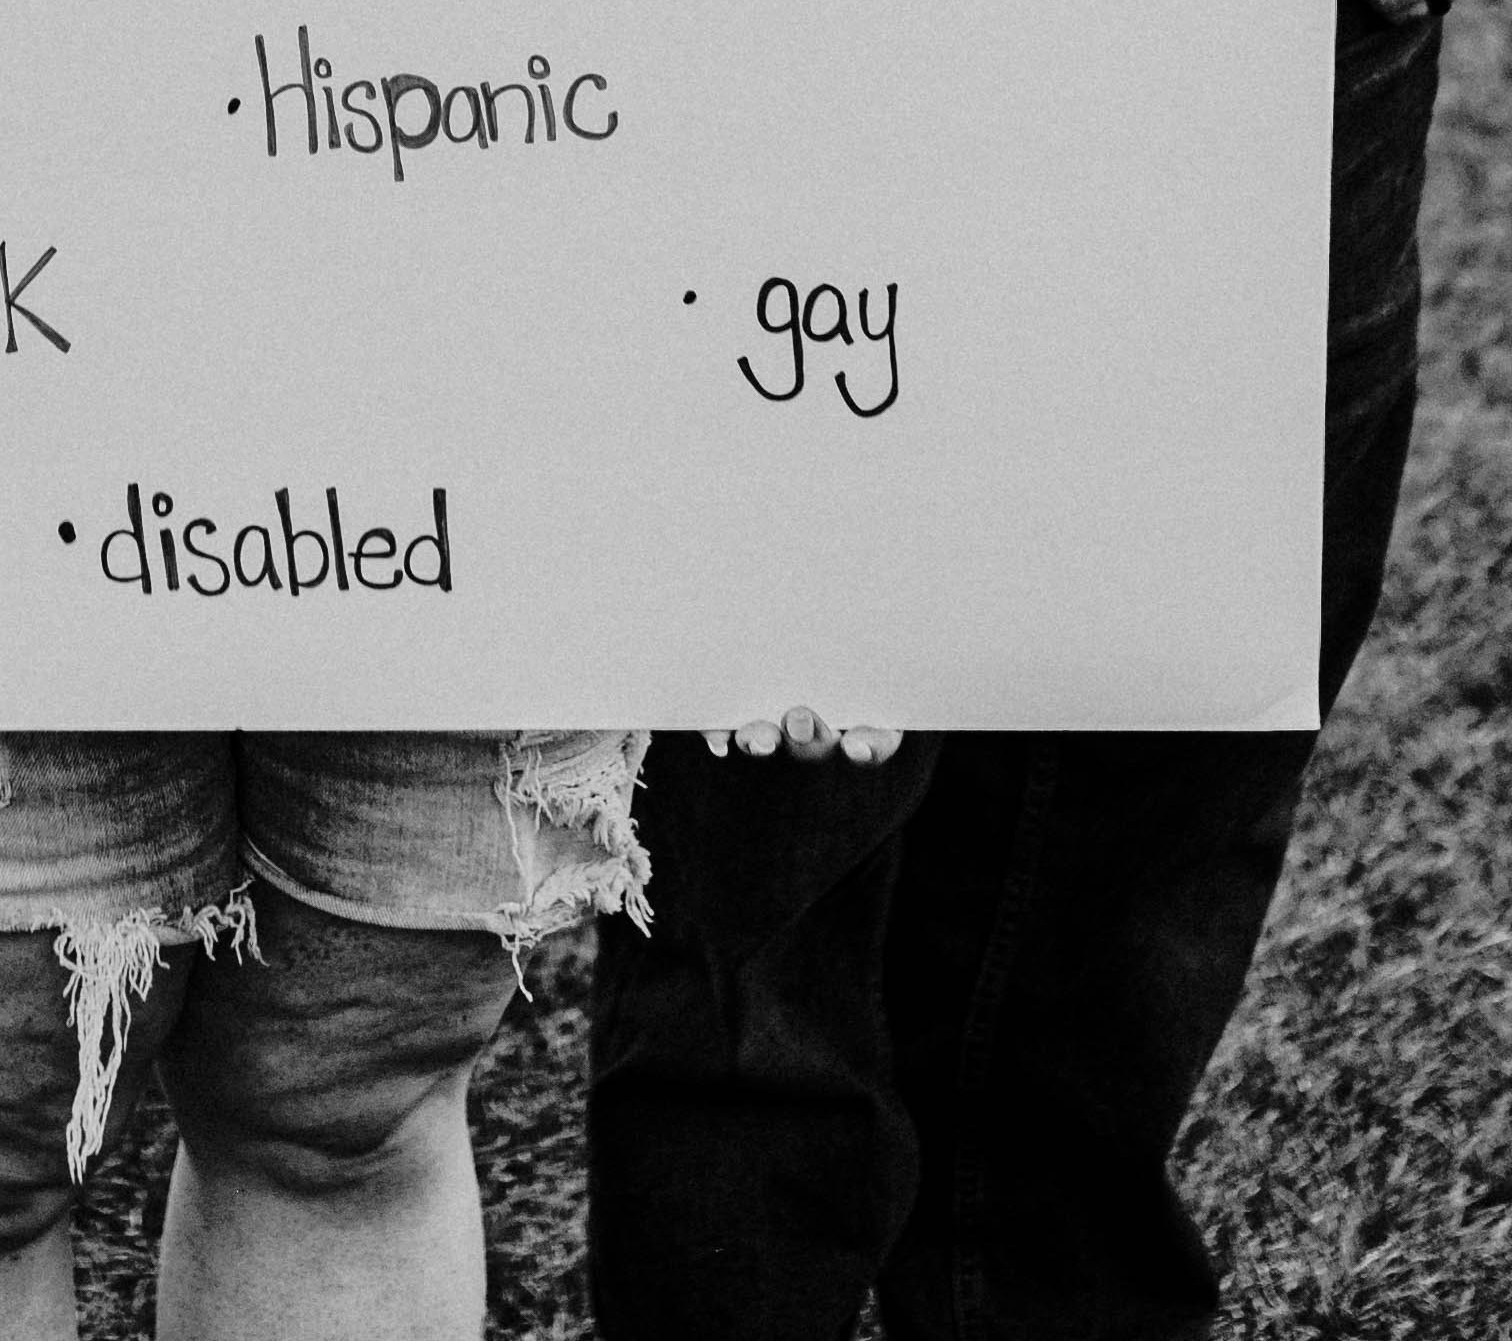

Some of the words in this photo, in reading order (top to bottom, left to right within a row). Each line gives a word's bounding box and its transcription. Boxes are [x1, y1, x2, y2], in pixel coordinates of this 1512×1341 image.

[254, 24, 620, 183] Hispanic
[736, 275, 901, 420] gay
[100, 482, 454, 598] disabled
